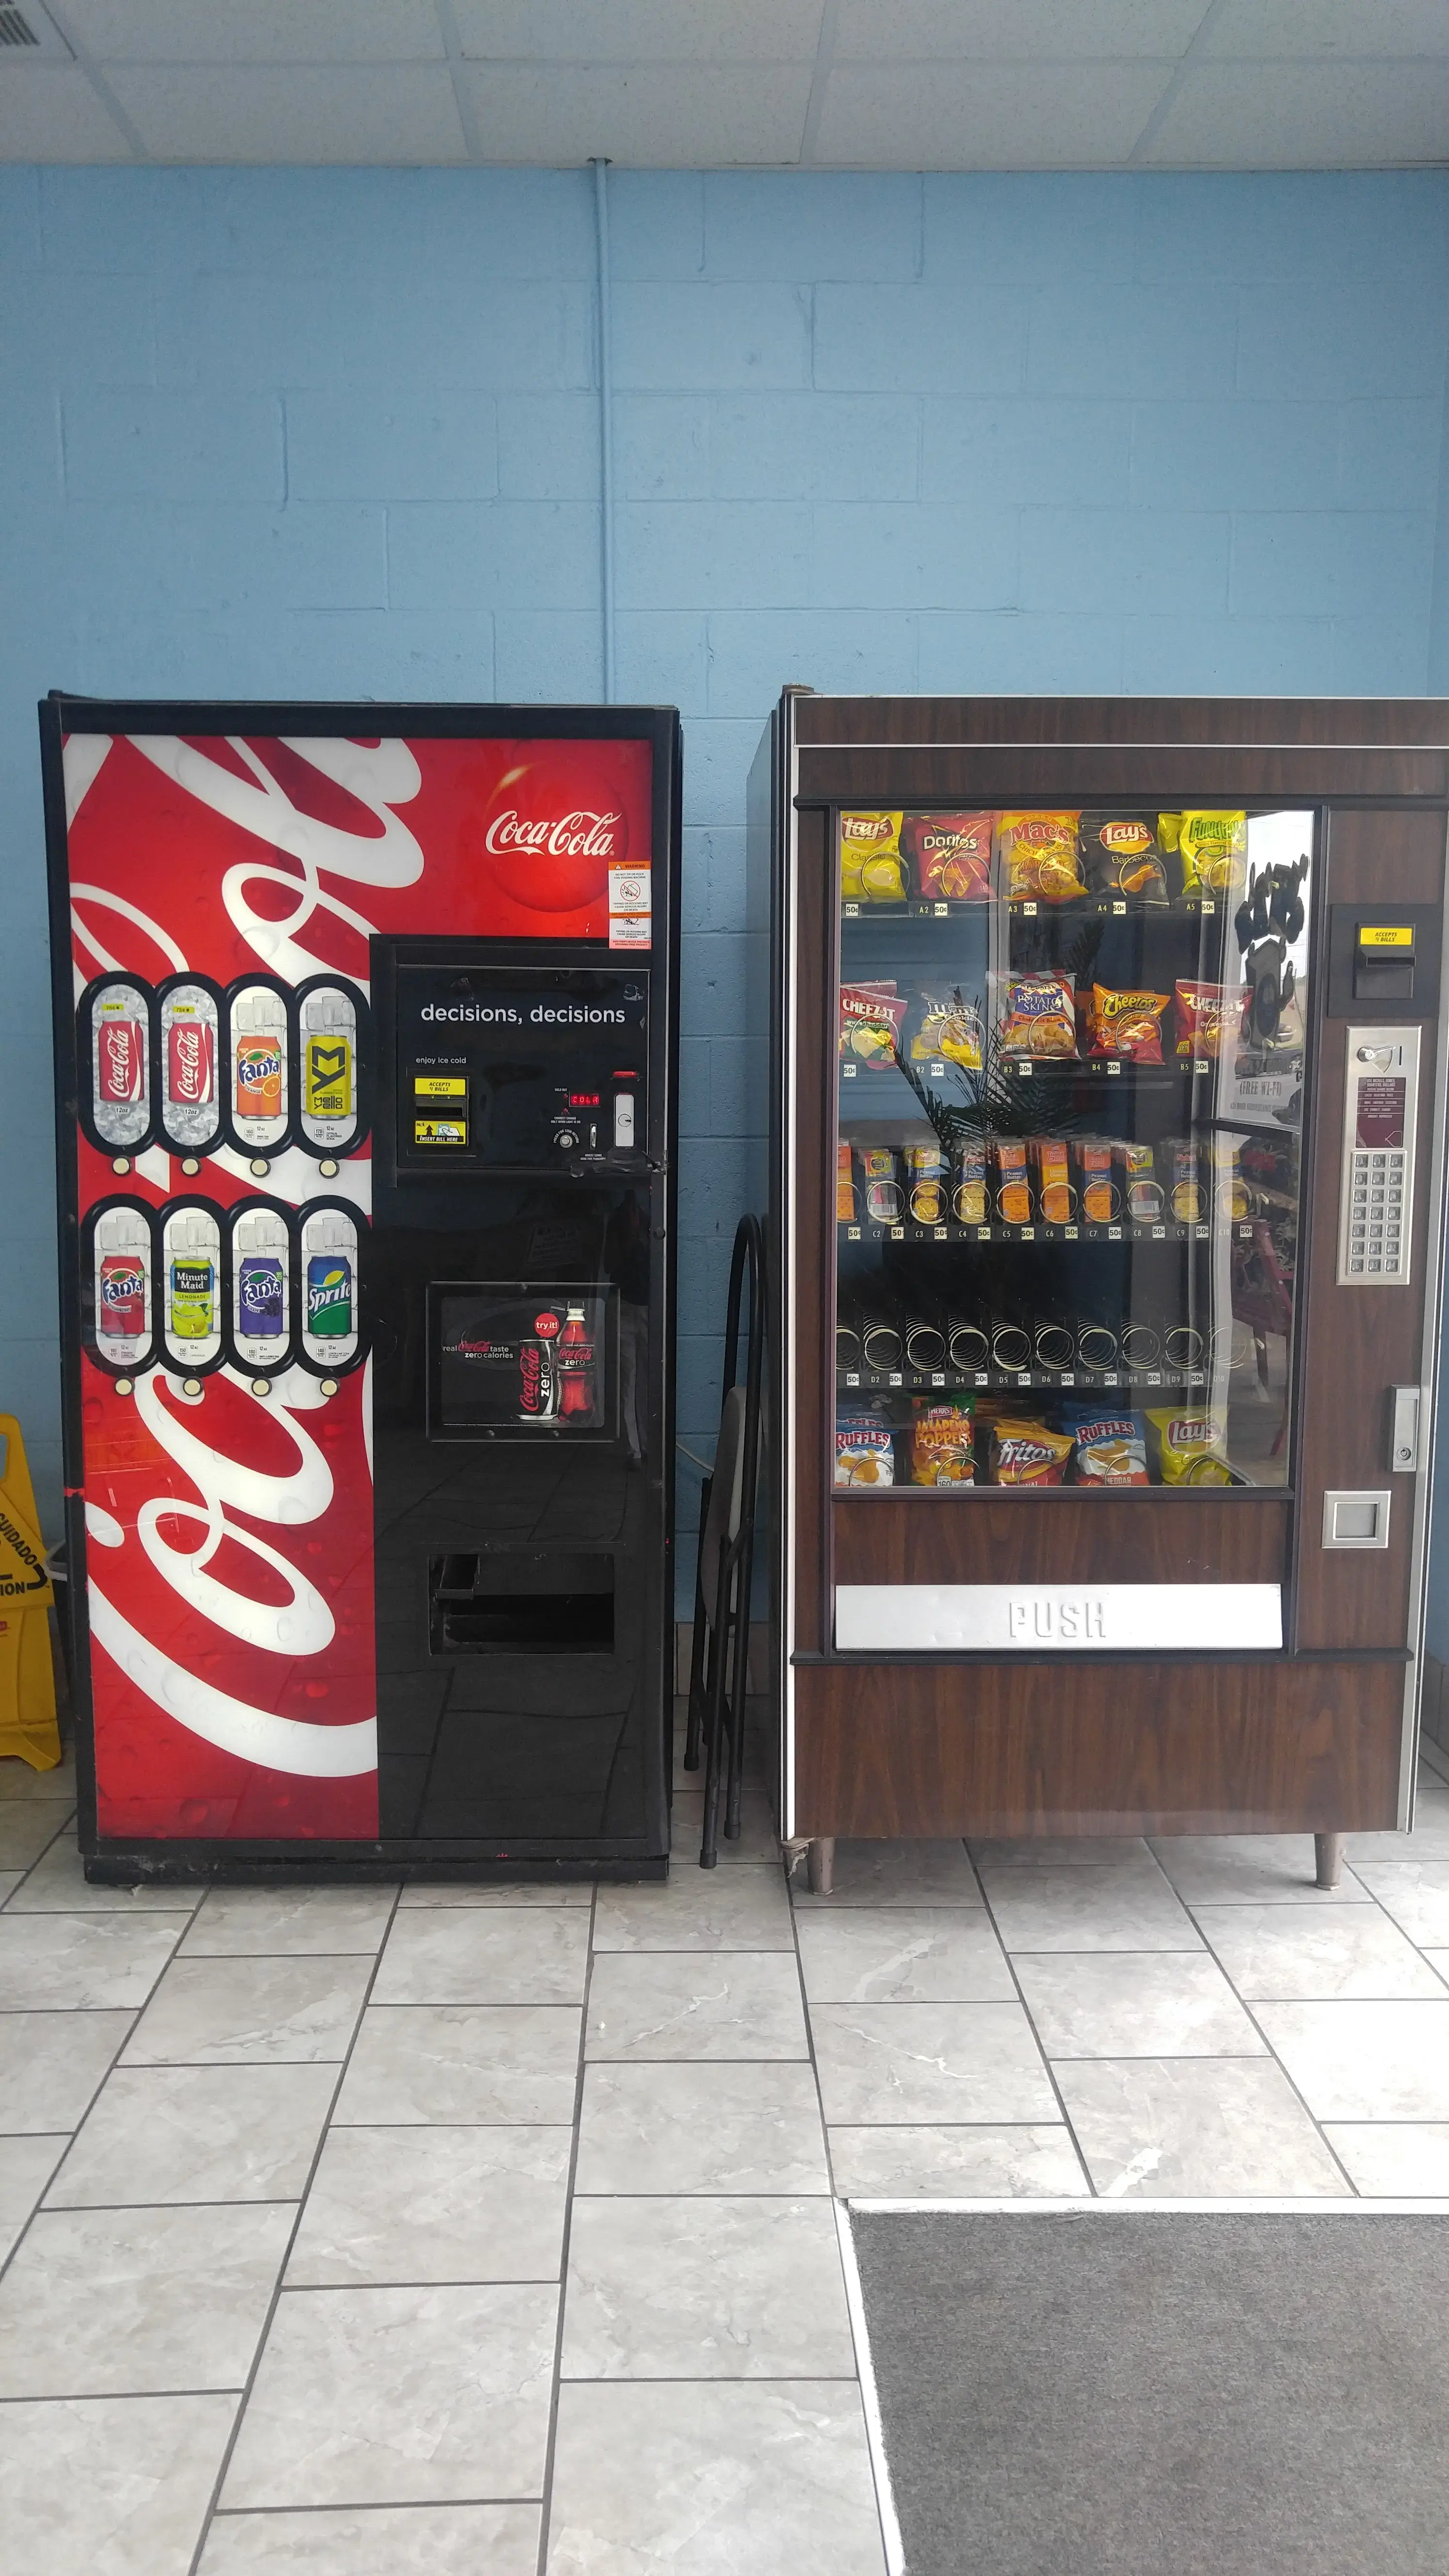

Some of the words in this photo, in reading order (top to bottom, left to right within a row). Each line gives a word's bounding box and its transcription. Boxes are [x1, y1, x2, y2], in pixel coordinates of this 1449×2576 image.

[485, 810, 622, 856] Coca-Cola
[924, 834, 977, 850] Doritos
[1011, 823, 1070, 846] Mac's
[1106, 825, 1148, 844] Lay's
[421, 1004, 522, 1025] decisions,
[530, 1005, 625, 1023] decisions
[1024, 1003, 1055, 1012] SKINS
[1104, 996, 1155, 1016] Cheetos
[107, 1026, 129, 1097] Coca-Cola
[177, 1028, 199, 1099] Coca-Cola
[239, 1057, 279, 1085] Fanta
[177, 1272, 208, 1281] Minute
[181, 1281, 204, 1289] Maid
[102, 1276, 143, 1305] Fanta
[241, 1276, 281, 1306] Fanta
[308, 1279, 351, 1313] Sprite
[559, 1348, 592, 1360] Coca-Cola
[520, 1346, 539, 1411] Coca-Cola
[541, 1362, 550, 1397] zero
[836, 1432, 890, 1449] RUFFLES
[1077, 1422, 1135, 1444] RUFFLES
[997, 1438, 1056, 1466] Fritos
[1009, 1602, 1106, 1638] PUSH
